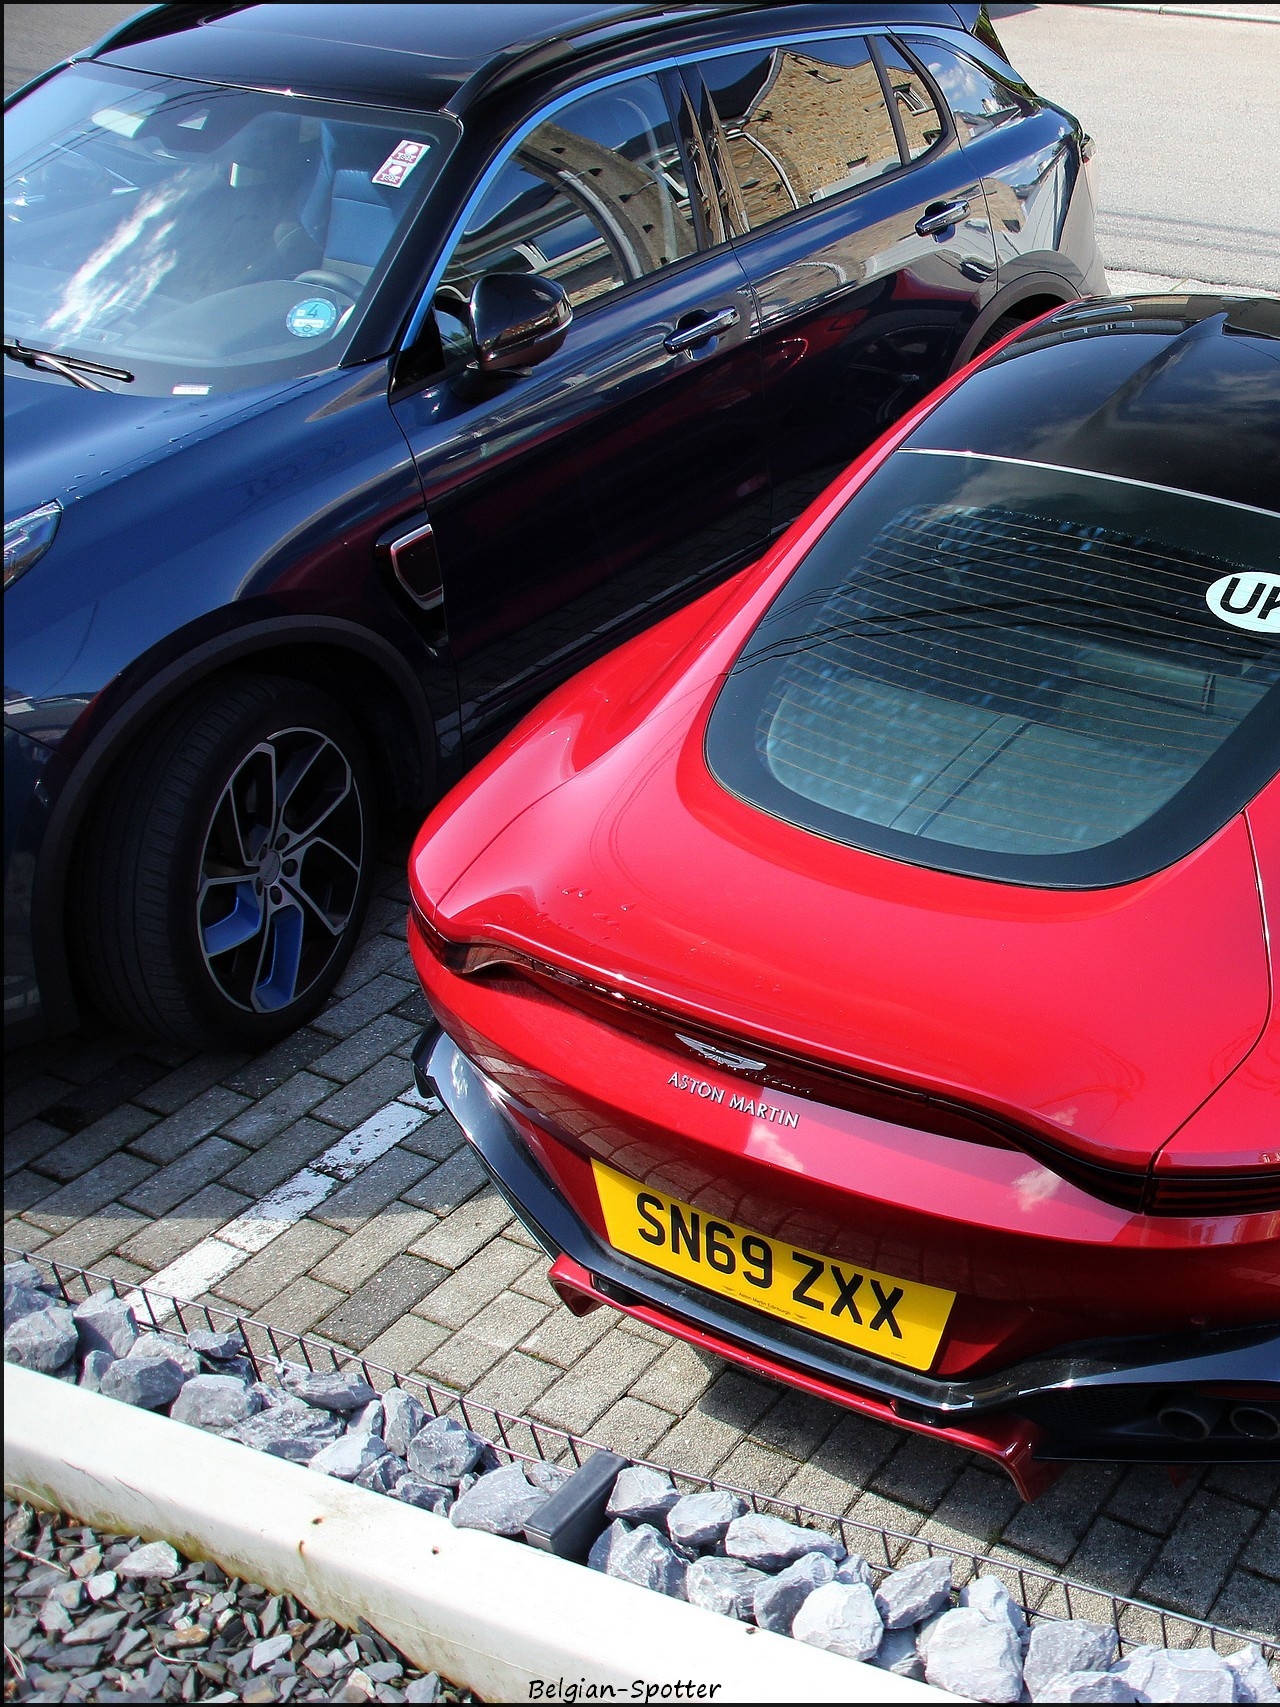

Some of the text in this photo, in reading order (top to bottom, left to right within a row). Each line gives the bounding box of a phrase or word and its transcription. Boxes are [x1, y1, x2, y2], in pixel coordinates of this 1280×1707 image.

[306, 303, 319, 318] 4
[667, 1071, 800, 1129] ASTON MARTIN
[636, 1192, 904, 1339] SN69 ZXX
